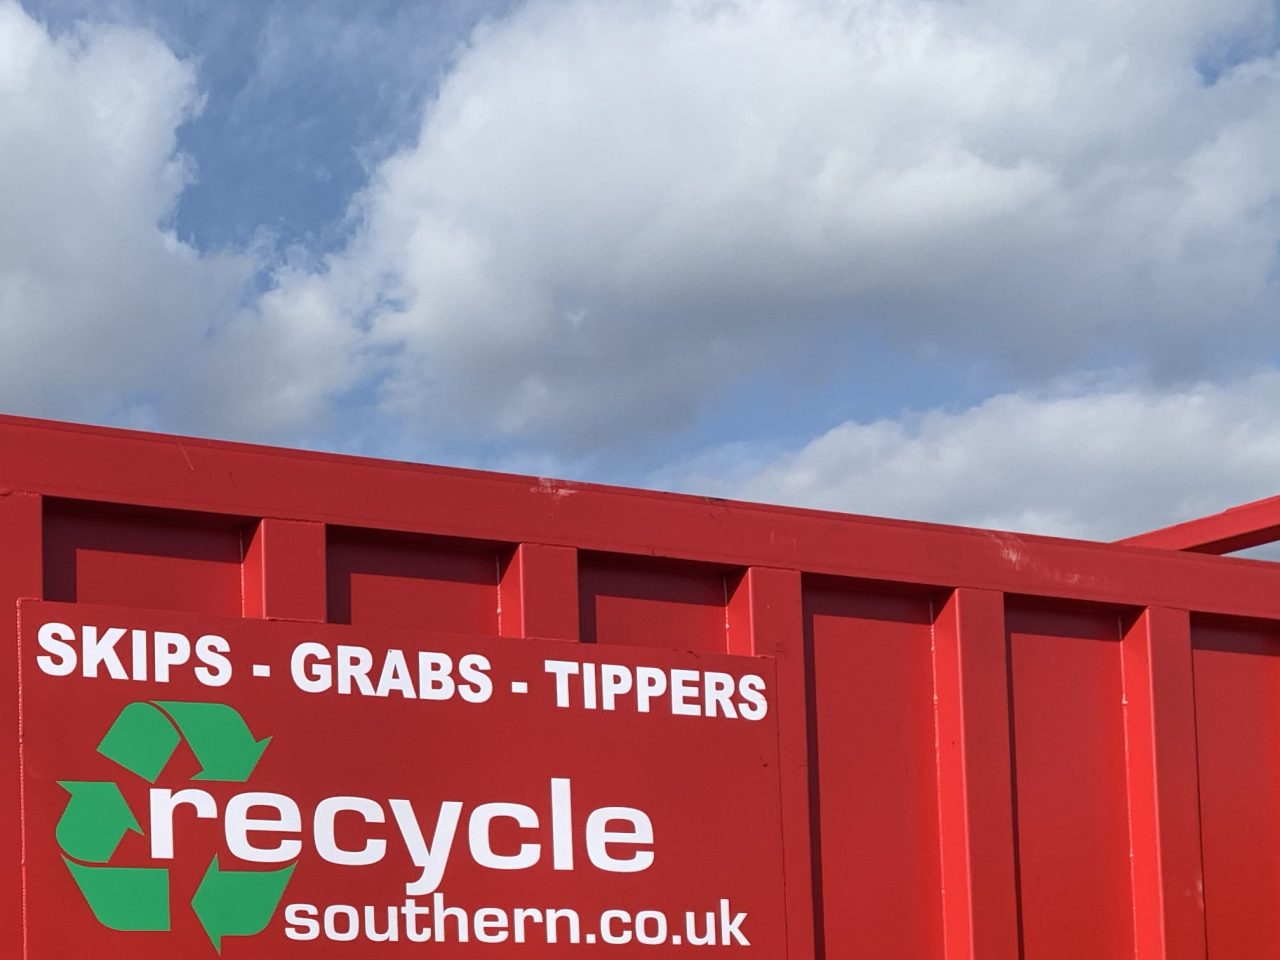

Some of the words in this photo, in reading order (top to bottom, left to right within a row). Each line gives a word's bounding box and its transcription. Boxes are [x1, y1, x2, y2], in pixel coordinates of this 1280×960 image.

[36, 622, 233, 687] SKIPS
[252, 664, 271, 678] -
[290, 641, 493, 704] GRABS
[511, 681, 528, 694] -
[544, 659, 768, 721] TIPPERS
[149, 777, 655, 895] recycle
[283, 892, 751, 947] southern.co.uk
